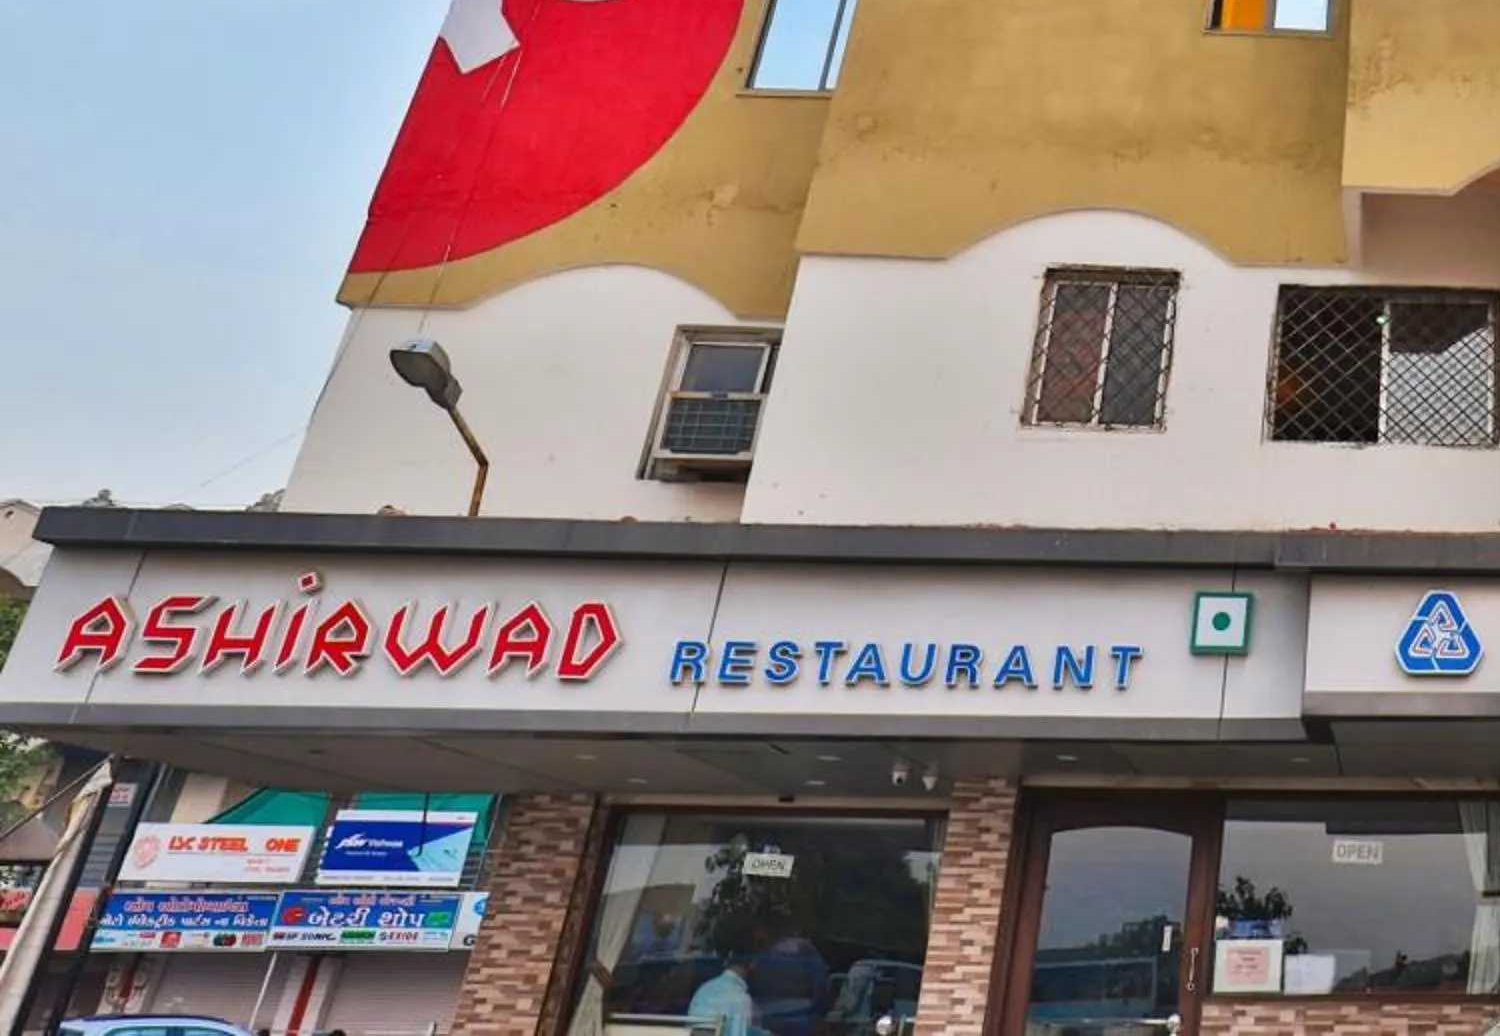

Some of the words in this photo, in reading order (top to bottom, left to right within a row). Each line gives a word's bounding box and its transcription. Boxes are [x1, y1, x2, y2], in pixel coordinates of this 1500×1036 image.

[668, 639, 1144, 691] RESTAURANT
[198, 835, 249, 852] STEEL
[1335, 843, 1382, 860] OPEN
